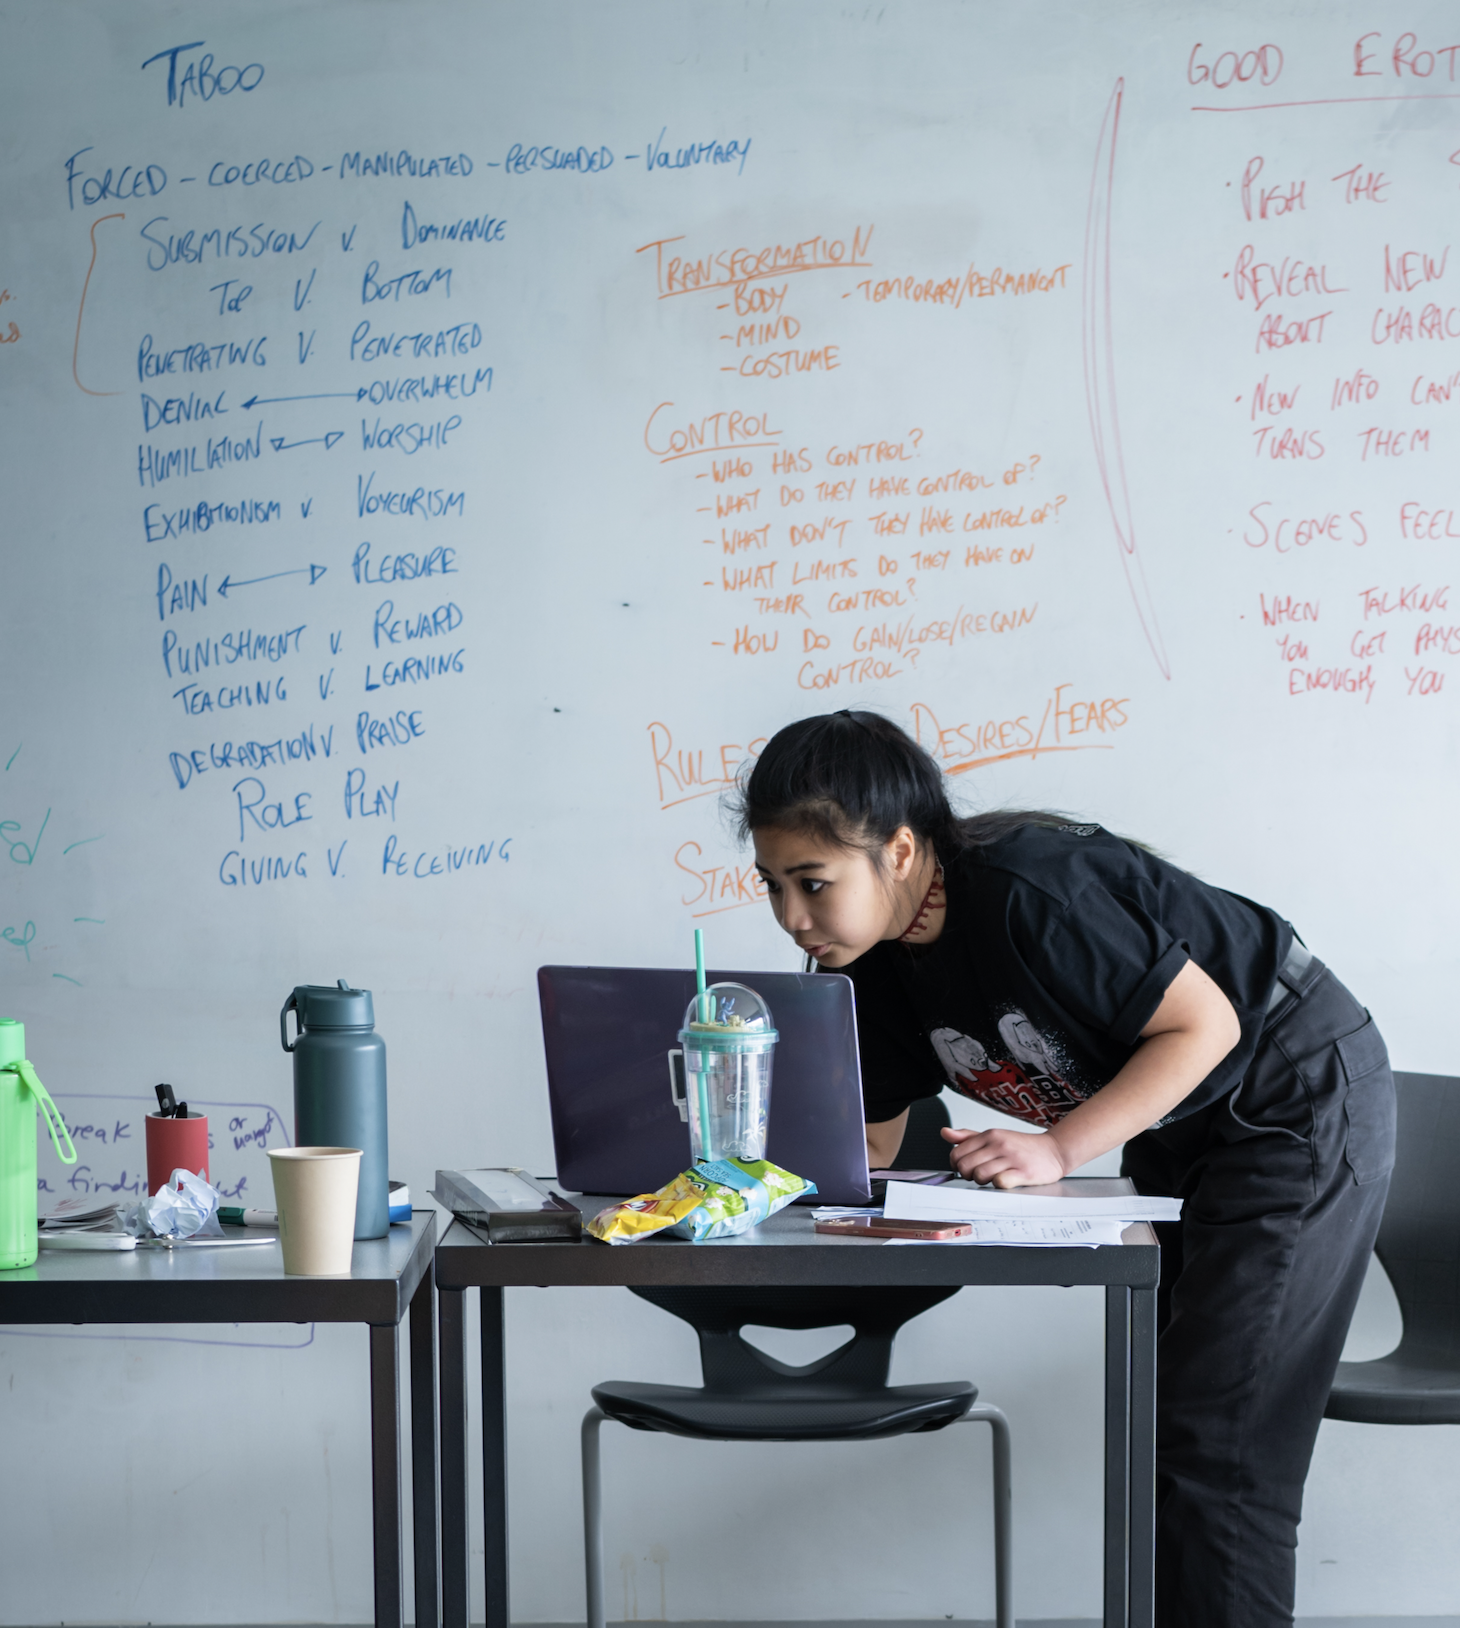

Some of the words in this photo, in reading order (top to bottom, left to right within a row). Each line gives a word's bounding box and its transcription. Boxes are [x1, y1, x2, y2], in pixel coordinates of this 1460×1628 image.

[141, 41, 265, 108] TABOO
[1188, 43, 1284, 89] GOOD
[64, 147, 167, 210] FORCED
[208, 155, 314, 186] COERCED
[340, 150, 473, 179] MANIPULATED
[647, 127, 752, 175] VOLUNTARY
[1332, 164, 1390, 204] THE
[140, 217, 321, 271] SUBMISSION
[401, 200, 507, 250] DOMINANCE
[635, 224, 874, 294] TRANSFORMATION
[362, 260, 453, 305] BOTTOM
[734, 283, 788, 316] BODY
[1234, 244, 1347, 311] REVEAL
[1384, 244, 1449, 292] NEW
[350, 320, 482, 362] PENETRATED
[737, 315, 801, 347] MIND
[1256, 311, 1332, 354] ABOUT
[739, 345, 840, 379] COSTUME
[140, 391, 228, 433] DENIAL
[1251, 374, 1300, 421] NEW
[1331, 369, 1379, 410] INFO
[362, 415, 462, 455] WORSHIP
[644, 401, 783, 455] CONTROL
[1253, 426, 1325, 460] TURNS
[1358, 427, 1430, 460] THEM
[712, 457, 753, 483] WHO
[772, 447, 812, 474] HAS
[826, 428, 923, 466] CONTROL?
[358, 471, 465, 520] VOYEURISM
[716, 488, 761, 518] WHAT
[780, 485, 804, 507] DO
[815, 479, 856, 501] THEY
[869, 476, 910, 499] HAVE
[917, 469, 994, 496] CONTROL
[722, 523, 771, 555] WHAT
[789, 517, 852, 547] DON'T
[868, 511, 910, 536] THEY
[919, 506, 954, 536] HAVE
[963, 506, 1027, 532] CONTROL
[1244, 502, 1367, 553] SCENES
[156, 563, 208, 621] PAIN
[351, 542, 458, 584] PLEASURE
[722, 561, 778, 591] WHAT
[792, 558, 857, 585] LIMITS
[878, 555, 898, 577] DO
[911, 550, 950, 570] THEY
[965, 545, 1003, 567] HAVE
[1010, 544, 1034, 564] ON
[754, 593, 810, 618] THEIR
[828, 577, 916, 613] CONTROL?
[1260, 593, 1318, 626] WHEN
[1359, 584, 1449, 620] TALKING
[162, 625, 307, 678] PUNISHMENT
[373, 600, 463, 649] REWARD
[733, 625, 778, 655] HOW
[803, 628, 830, 653] DO
[1350, 630, 1386, 659] GET
[172, 676, 287, 715] TEACHING
[365, 648, 465, 692] LEARNING
[797, 648, 920, 690] CONTROL?
[1405, 667, 1444, 695] YOU
[169, 724, 317, 790] DEGRADATION
[356, 710, 425, 754] PRAISE
[232, 777, 313, 842] ROLE
[344, 768, 399, 822] PLAY
[219, 850, 307, 886] GIVING
[382, 834, 512, 878] RECEIVING
